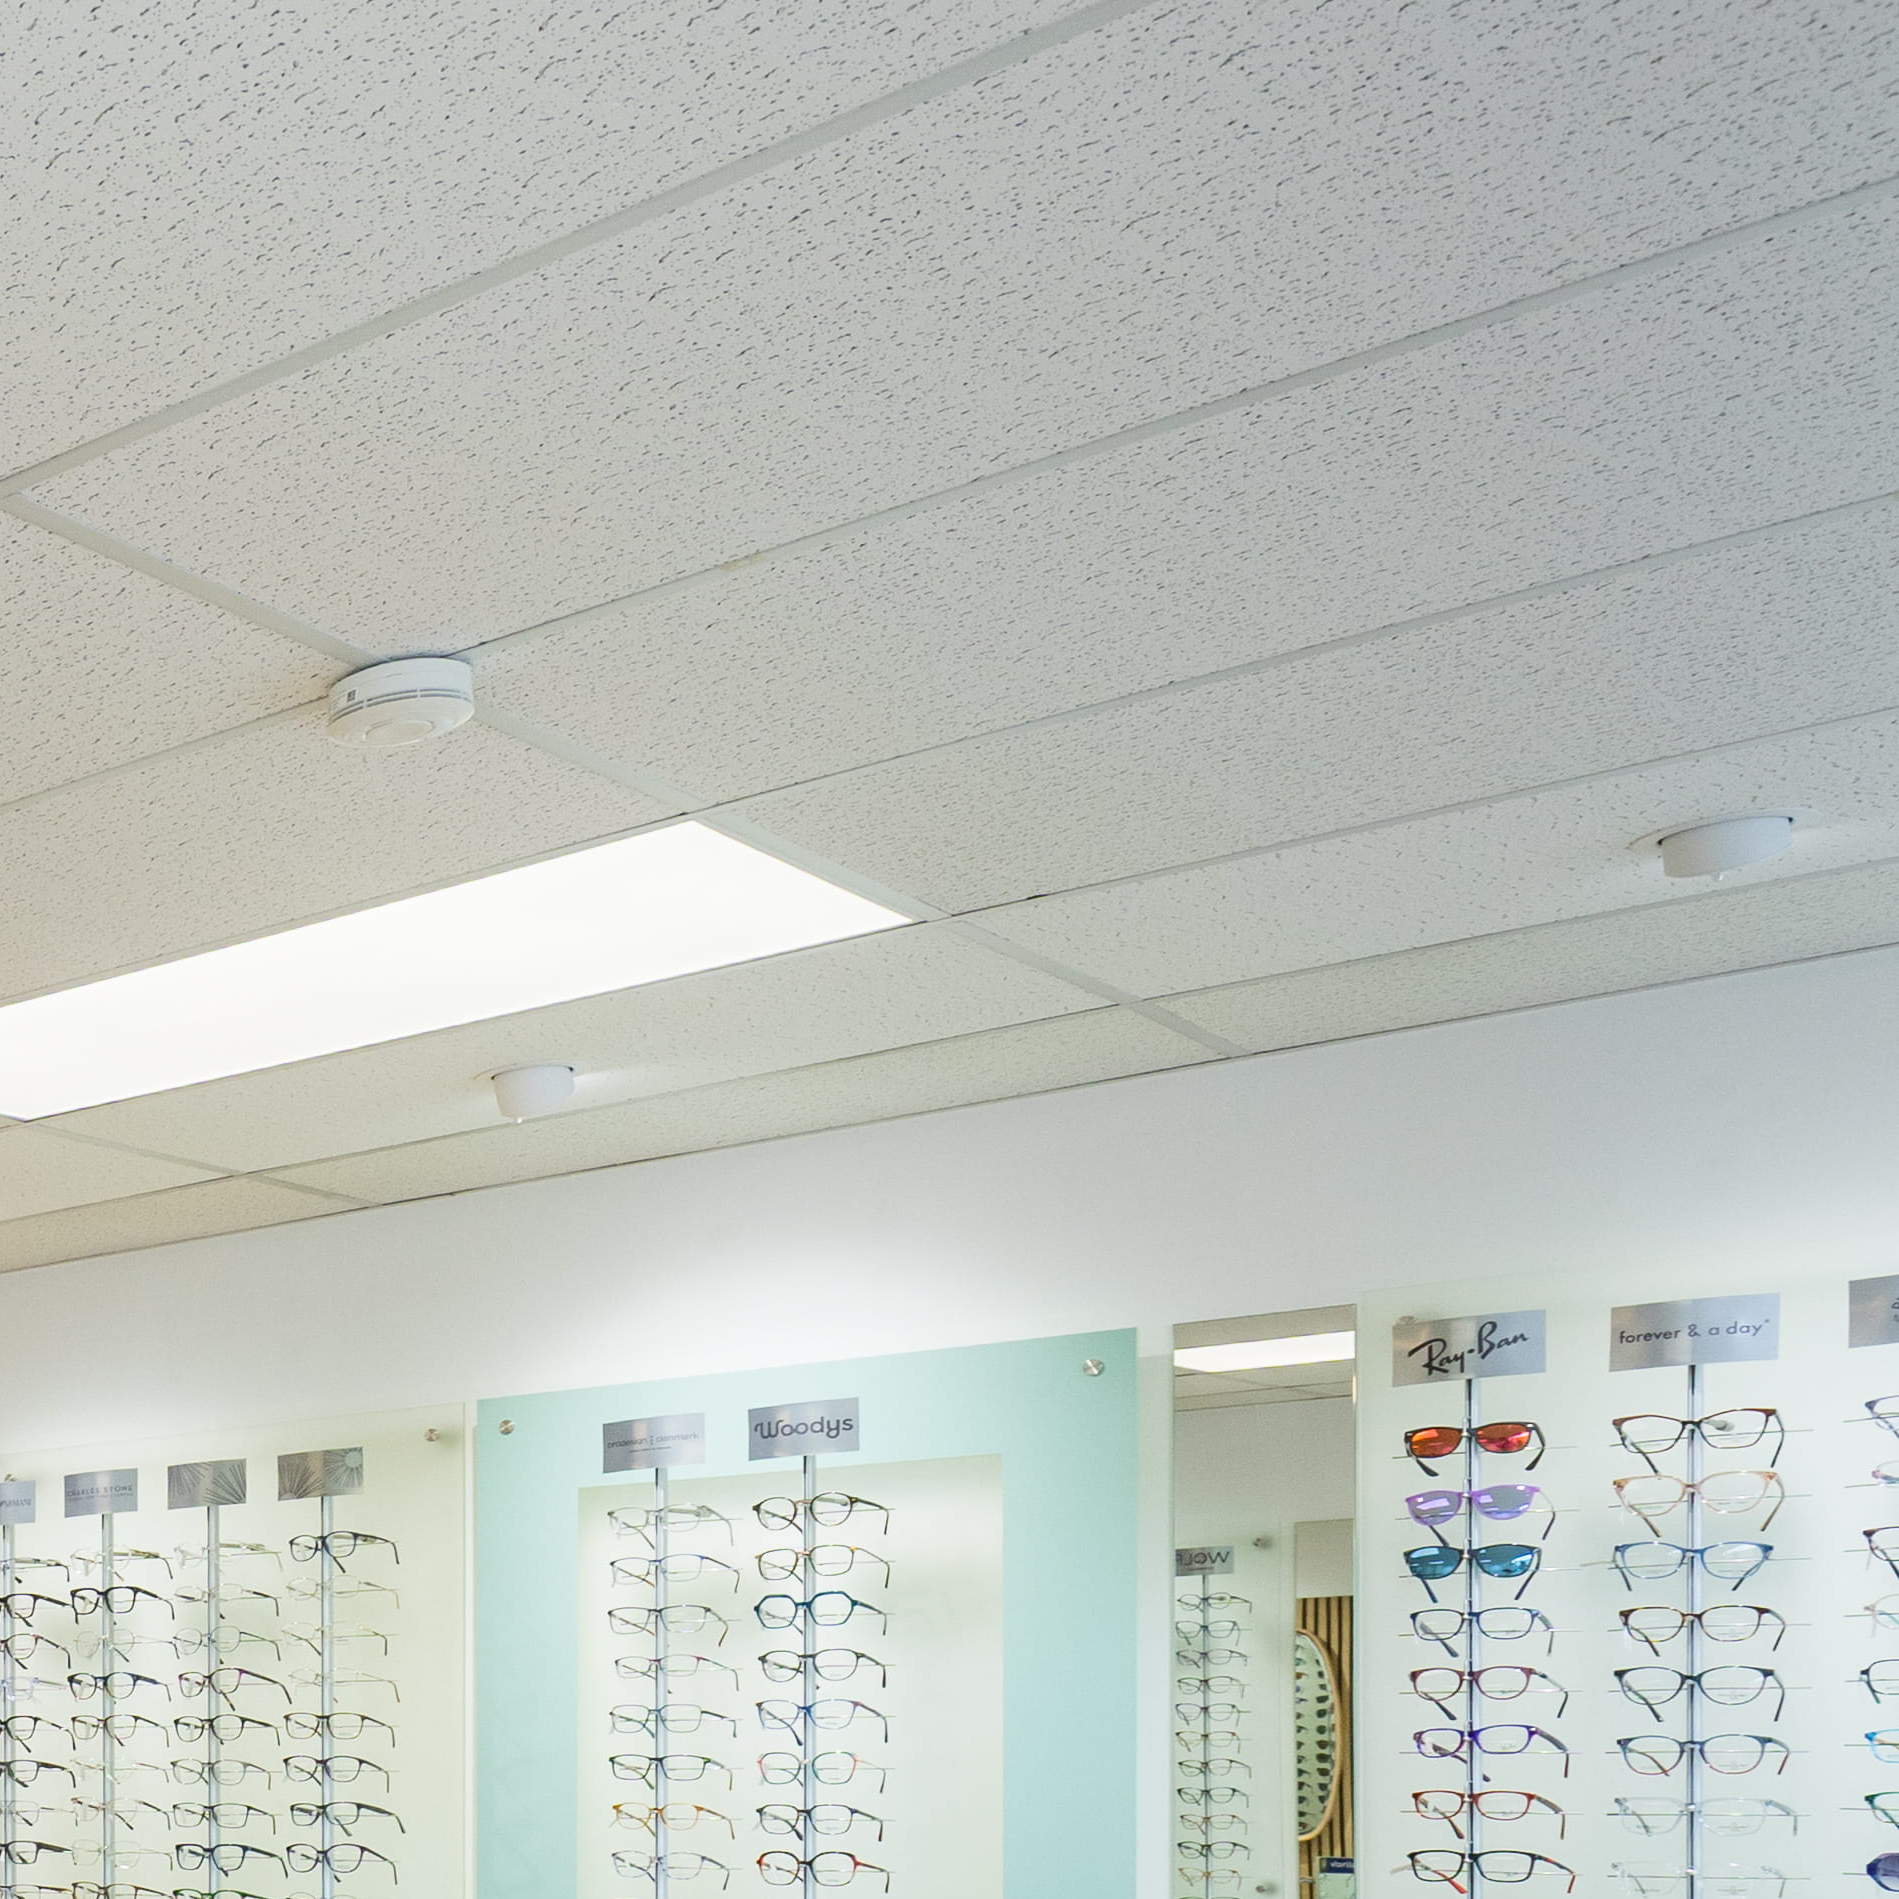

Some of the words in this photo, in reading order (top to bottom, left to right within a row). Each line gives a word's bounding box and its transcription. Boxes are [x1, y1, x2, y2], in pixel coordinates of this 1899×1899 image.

[1619, 1328, 1681, 1345] forever
[1688, 1323, 1701, 1338] &
[1708, 1326, 1720, 1336] a
[1725, 1320, 1764, 1337] day
[1408, 1320, 1530, 1376] Ray-Ban
[754, 1416, 854, 1439] Woodys
